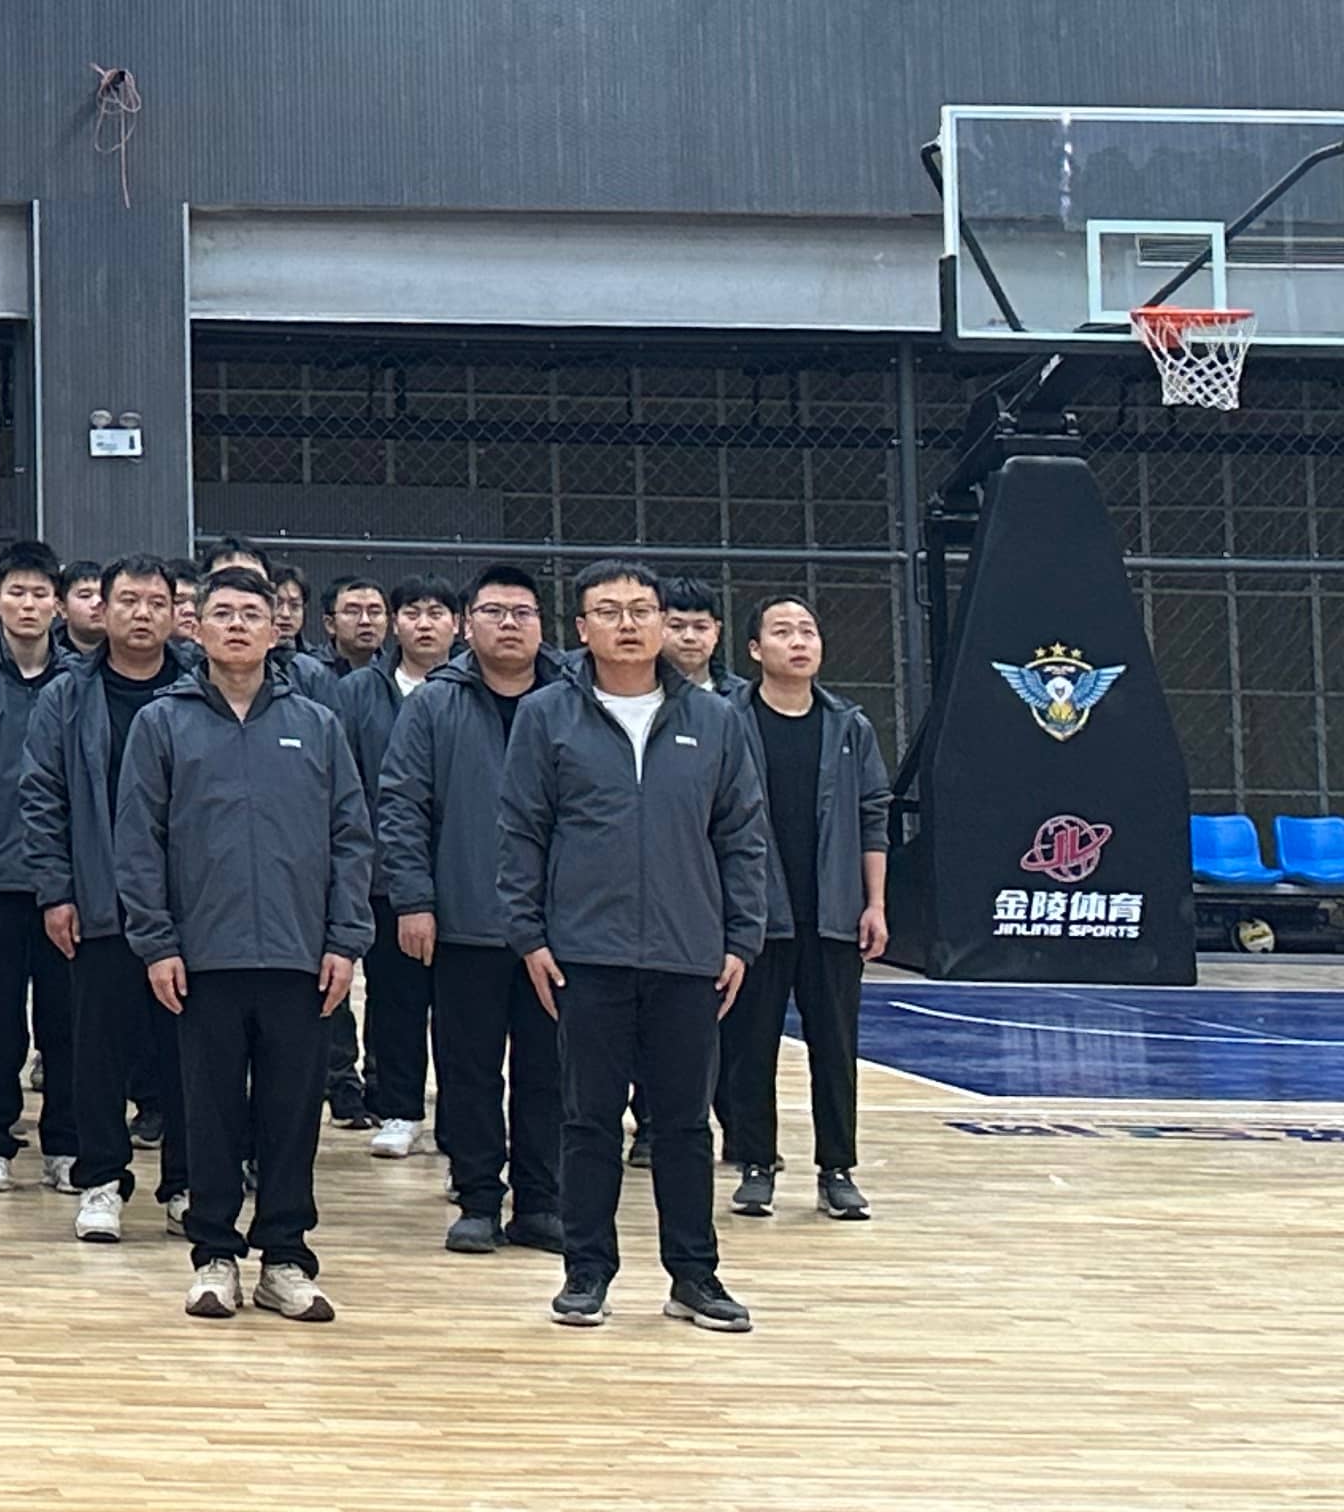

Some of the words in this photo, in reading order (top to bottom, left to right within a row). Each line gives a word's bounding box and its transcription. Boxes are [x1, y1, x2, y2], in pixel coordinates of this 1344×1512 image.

[993, 890, 1143, 922] 金陵体育
[1068, 924, 1140, 938] SPORTS
